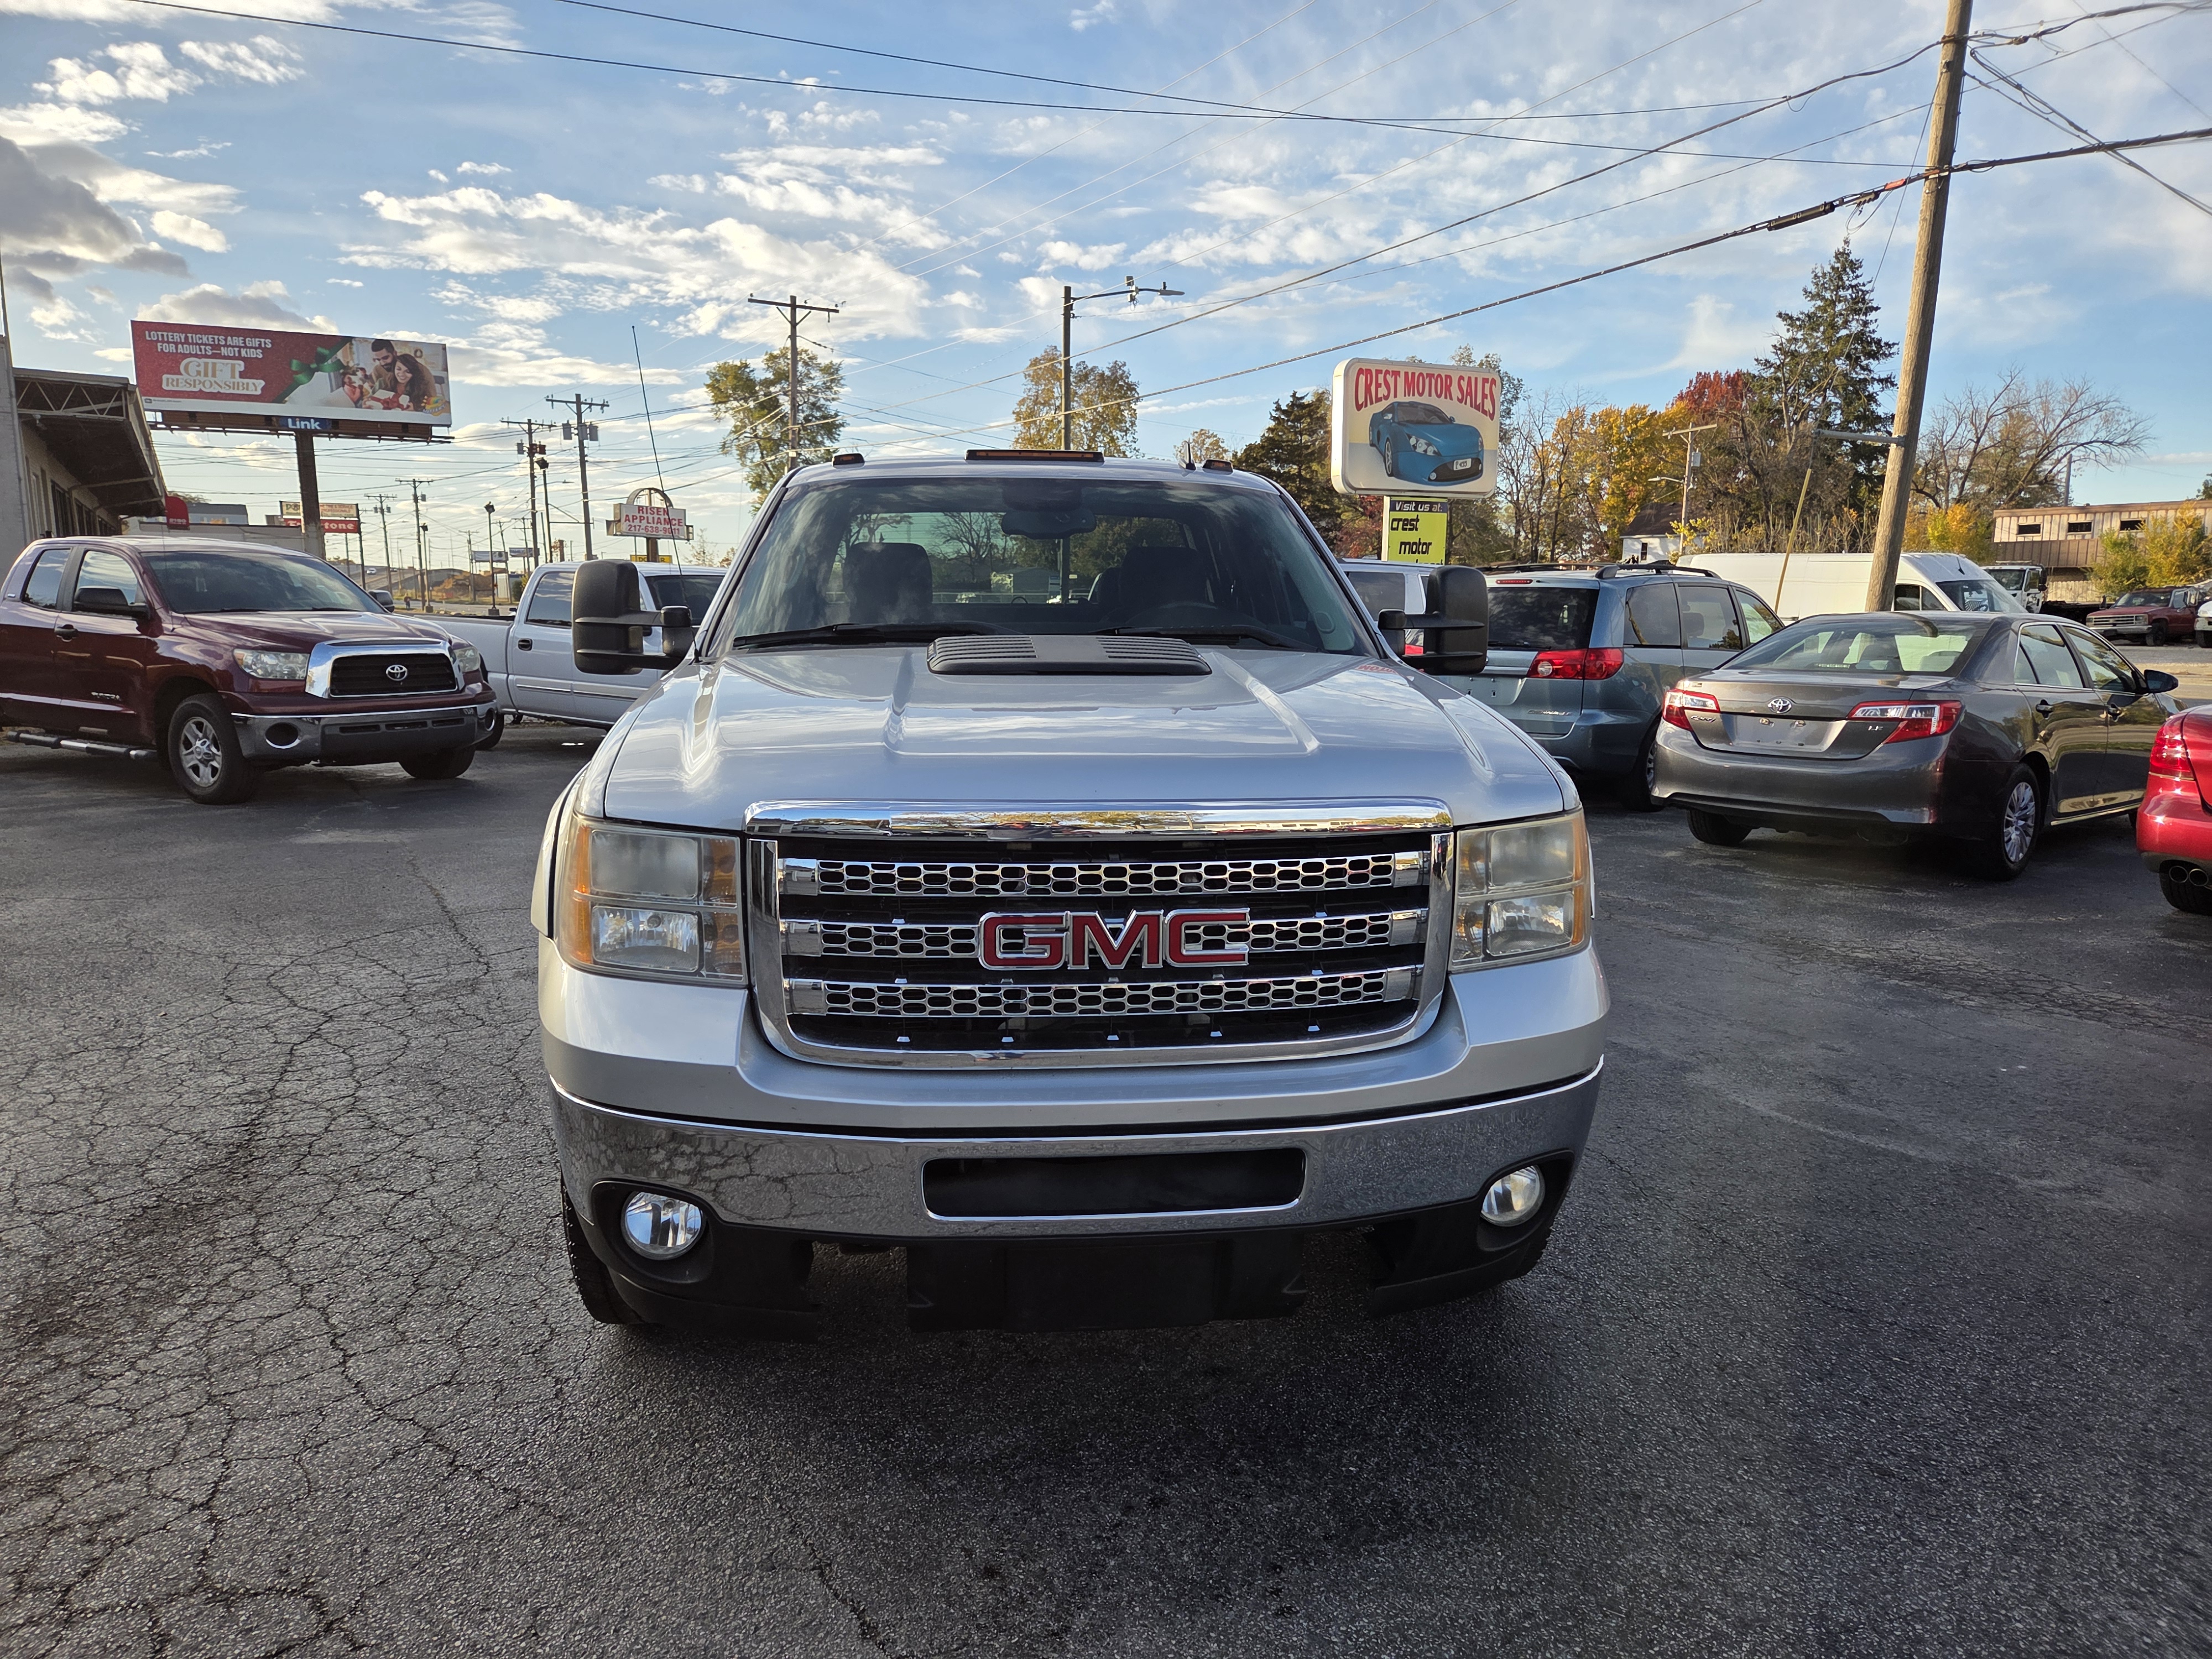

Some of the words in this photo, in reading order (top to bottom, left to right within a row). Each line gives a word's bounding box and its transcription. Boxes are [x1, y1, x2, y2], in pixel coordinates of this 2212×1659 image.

[145, 331, 185, 342] LOTTERY
[187, 333, 225, 345] TICKETS
[227, 336, 245, 347] ARE
[246, 338, 272, 348] GIFTS
[157, 343, 175, 353] FOR
[241, 349, 263, 358] KIDS
[183, 360, 241, 379] GIFT
[166, 378, 260, 392] RESPONSIBLY
[1355, 367, 1400, 411] CREST
[1404, 371, 1453, 401] MOTOR
[1457, 375, 1496, 421] SALES
[288, 418, 322, 430] Link
[638, 506, 669, 516] RISEN
[1396, 502, 1416, 511] Visit
[1432, 503, 1443, 512] at:
[624, 514, 684, 526] APPLIANCE
[1390, 514, 1420, 531] crest
[1399, 538, 1432, 555] motor
[978, 907, 1250, 970] GMC
